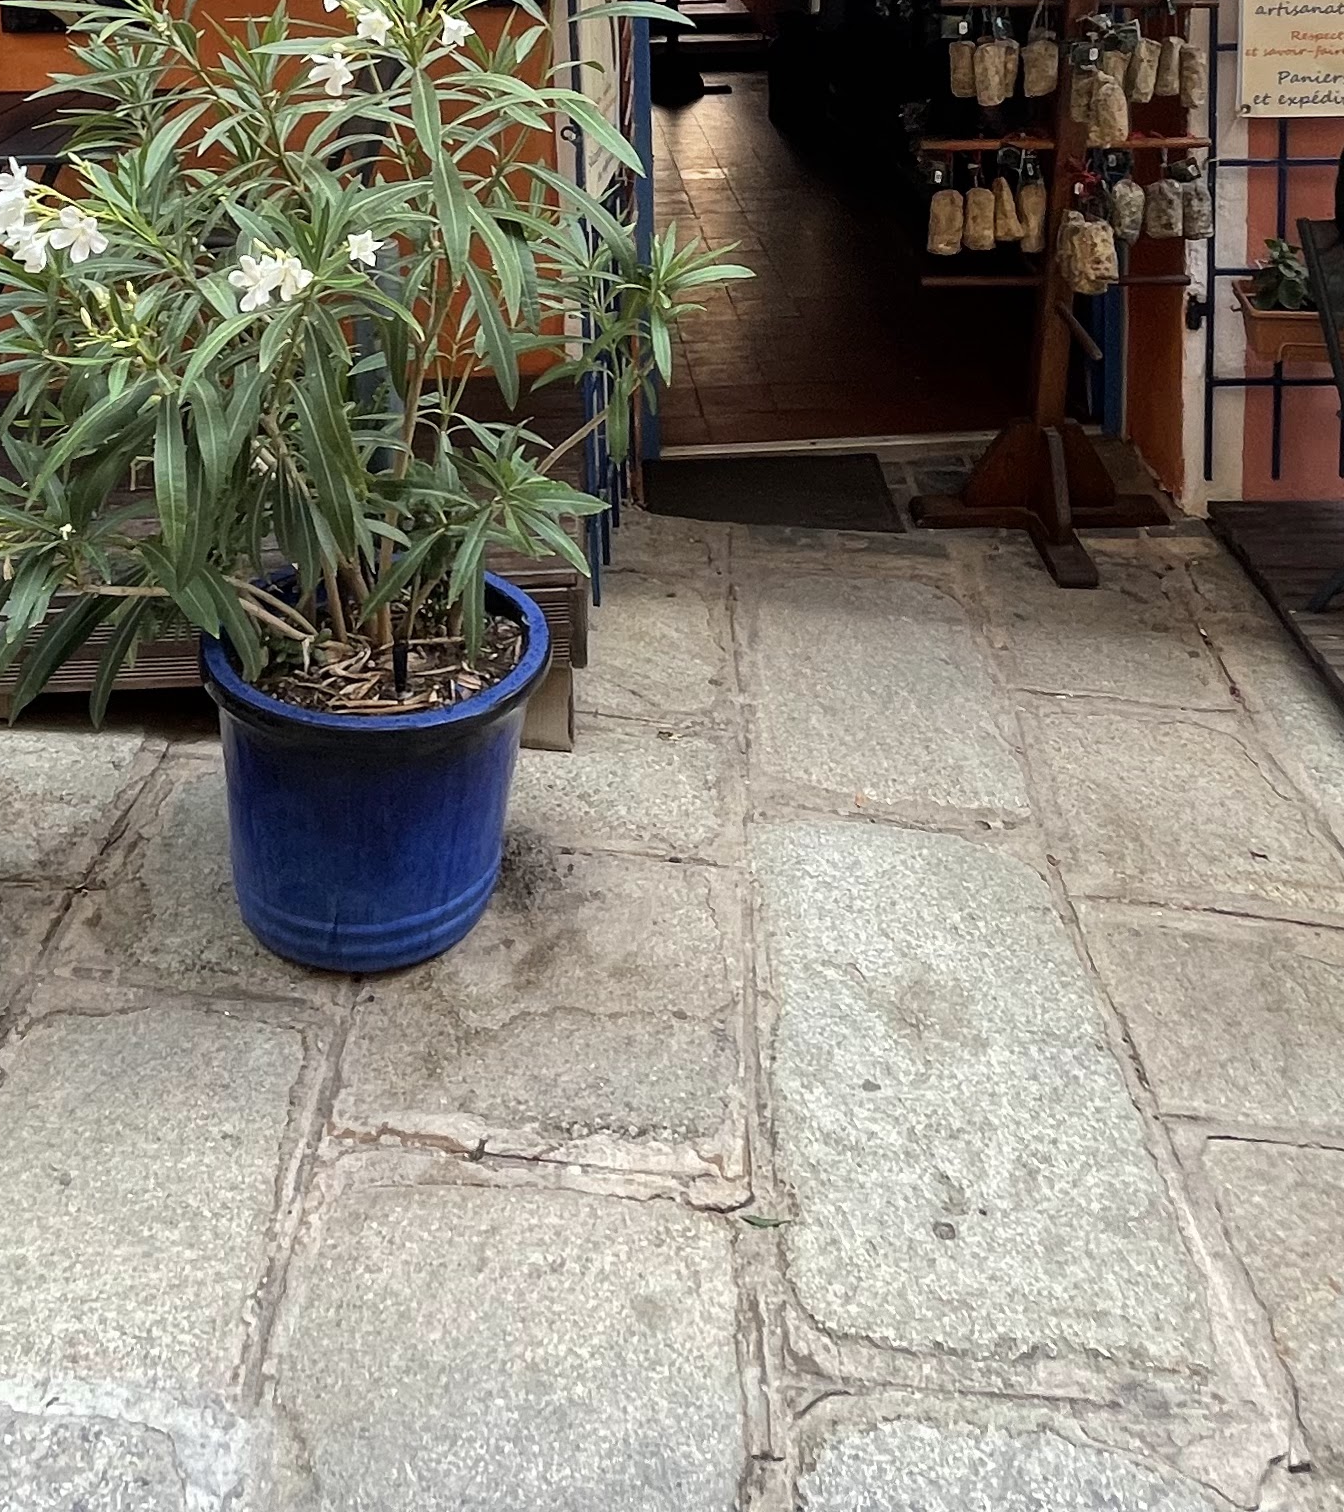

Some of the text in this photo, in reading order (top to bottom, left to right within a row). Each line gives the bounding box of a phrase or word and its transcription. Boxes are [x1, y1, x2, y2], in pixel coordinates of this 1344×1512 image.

[1291, 30, 1344, 44] Respect
[1244, 47, 1258, 57] et
[1253, 93, 1272, 105] et
